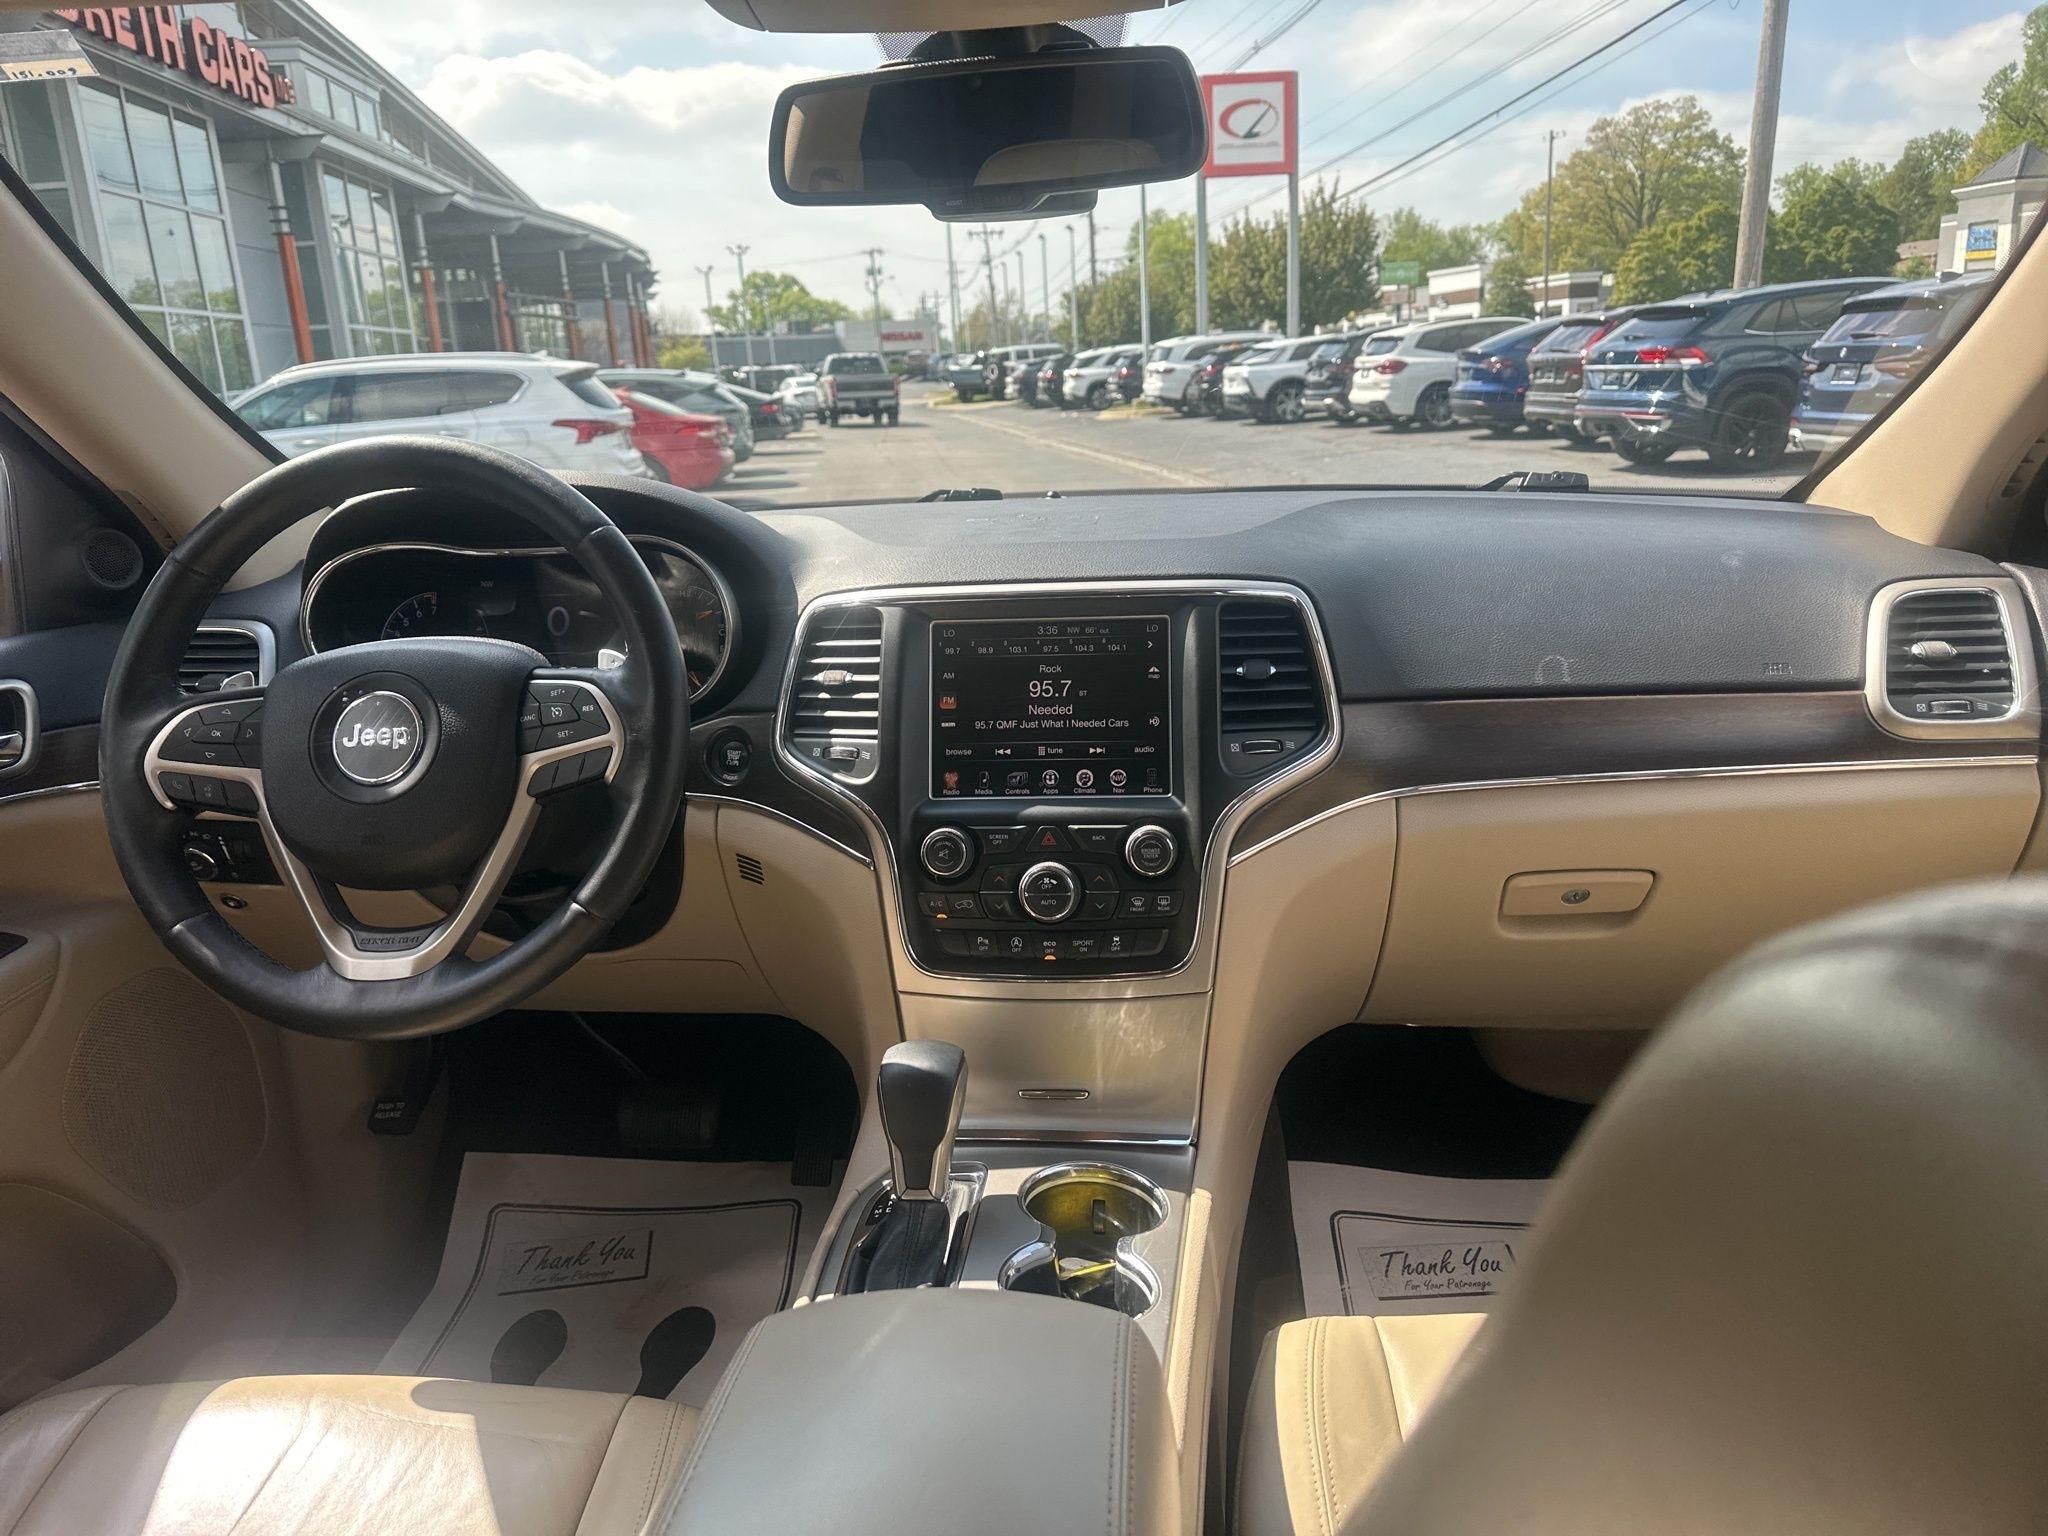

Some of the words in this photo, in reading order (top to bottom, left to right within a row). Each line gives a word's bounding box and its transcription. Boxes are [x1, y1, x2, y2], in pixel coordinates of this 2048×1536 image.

[191, 16, 276, 109] CARS
[416, 609, 422, 618] 6
[403, 618, 409, 626] 5
[547, 606, 570, 637] 0
[1037, 626, 1058, 635] 3:36
[1146, 624, 1158, 632] LO
[944, 630, 956, 638] LO
[1039, 664, 1062, 673] Rock
[1029, 680, 1072, 698] 95.7
[943, 696, 955, 704] FM
[1028, 704, 1073, 715] Needed
[975, 720, 993, 730] 95.7
[996, 720, 1018, 729] QMF
[1020, 720, 1039, 729] Just
[1041, 719, 1064, 728] What
[1071, 718, 1106, 728] Needed
[1108, 718, 1130, 727] Cars
[342, 722, 411, 749] Jeep
[946, 748, 972, 756] browse
[1047, 746, 1063, 754] tune
[1134, 745, 1155, 753] audio
[943, 788, 960, 796] Radio
[1005, 787, 1030, 795] Controls
[1043, 788, 1059, 796] Apps
[516, 1240, 596, 1275] Thank
[600, 1235, 636, 1265] You
[1380, 1249, 1456, 1279] Thank
[1463, 1246, 1504, 1275] You
[1404, 1280, 1420, 1291] For
[1423, 1279, 1444, 1290] Your
[1447, 1278, 1492, 1291] Patronage
